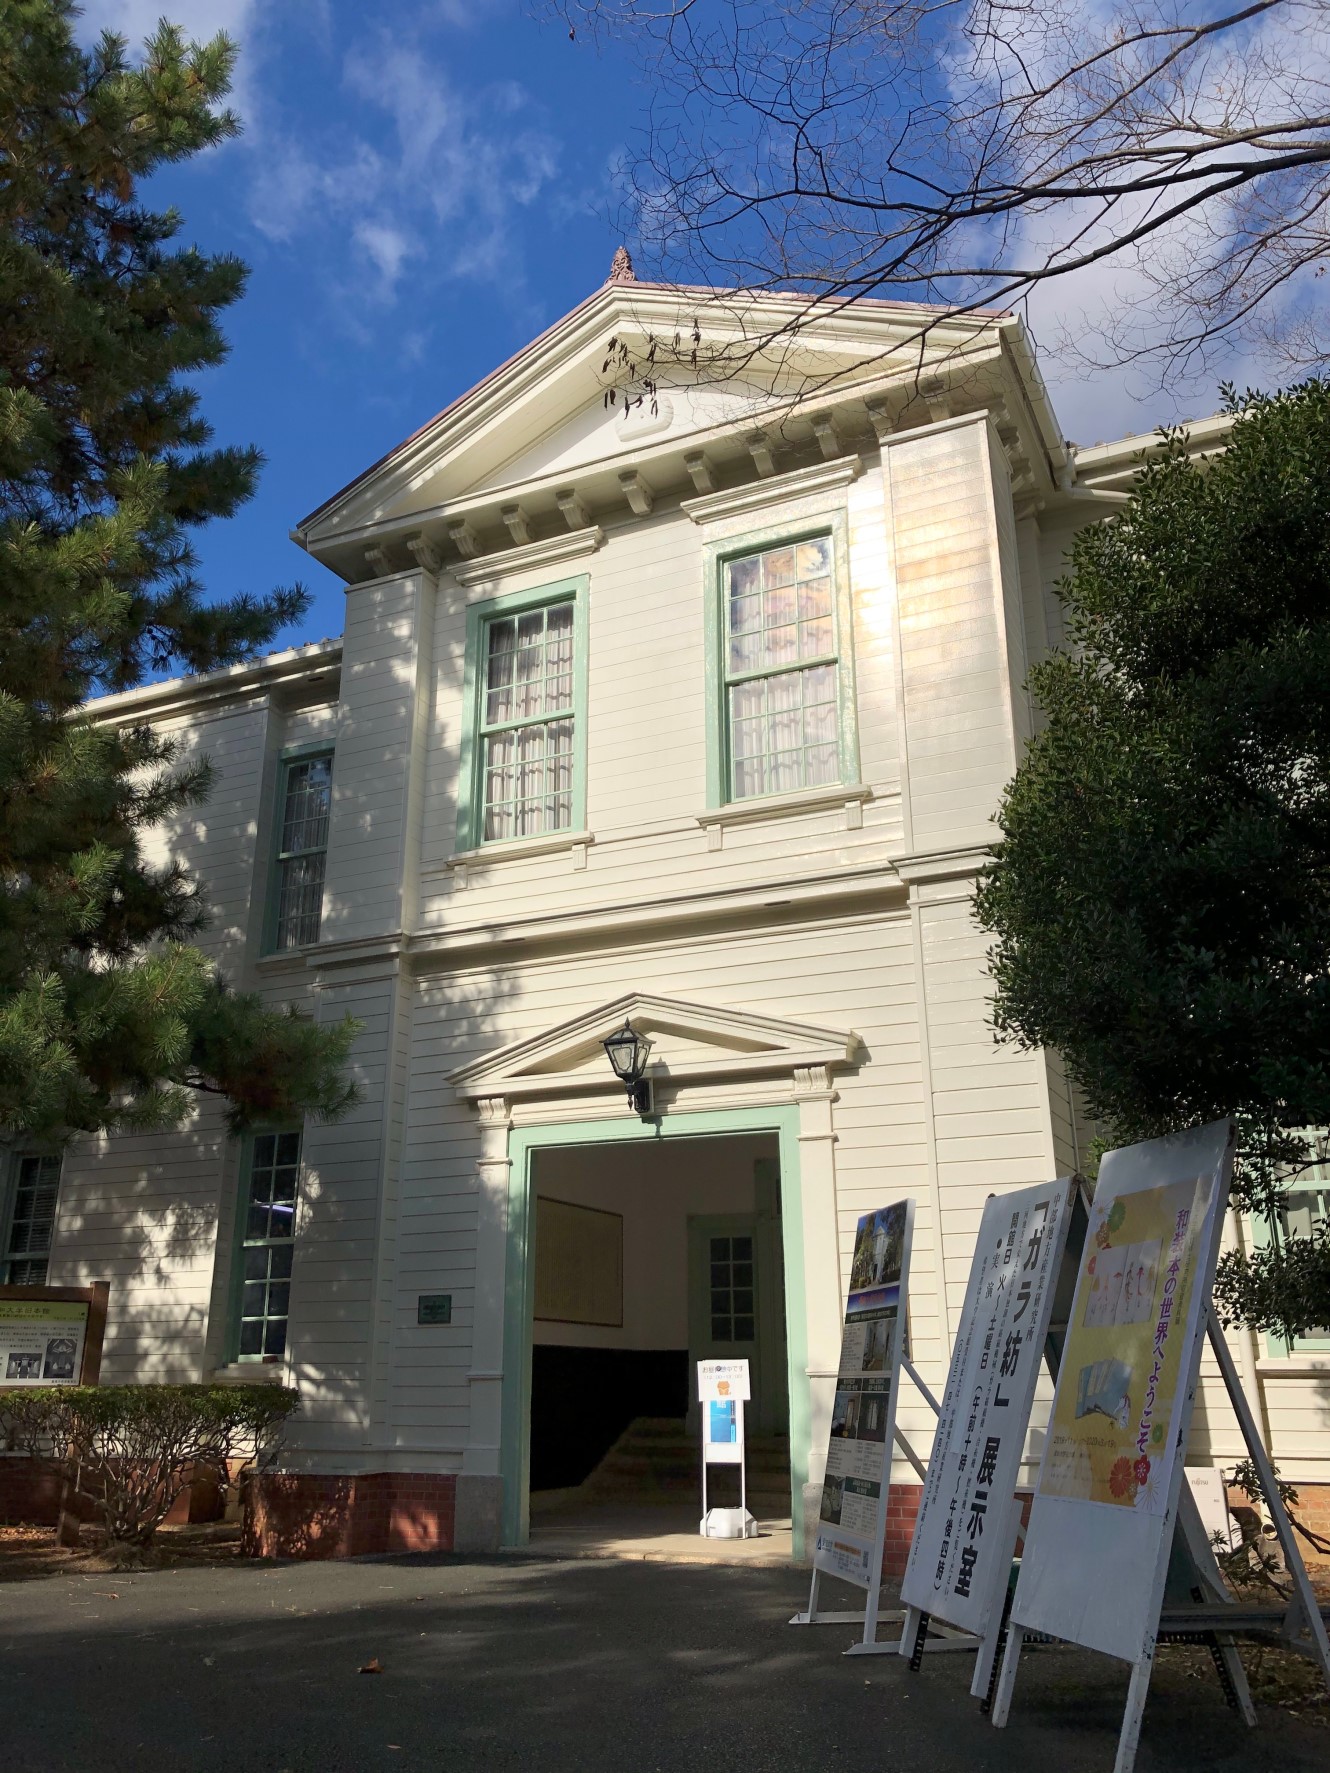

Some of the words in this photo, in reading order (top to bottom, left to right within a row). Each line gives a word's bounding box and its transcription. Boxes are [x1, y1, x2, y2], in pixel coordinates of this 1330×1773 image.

[954, 1200, 1050, 1598] 「ガラ紡」展示室
[1137, 1209, 1190, 1453] 和装本の世界へようこそ
